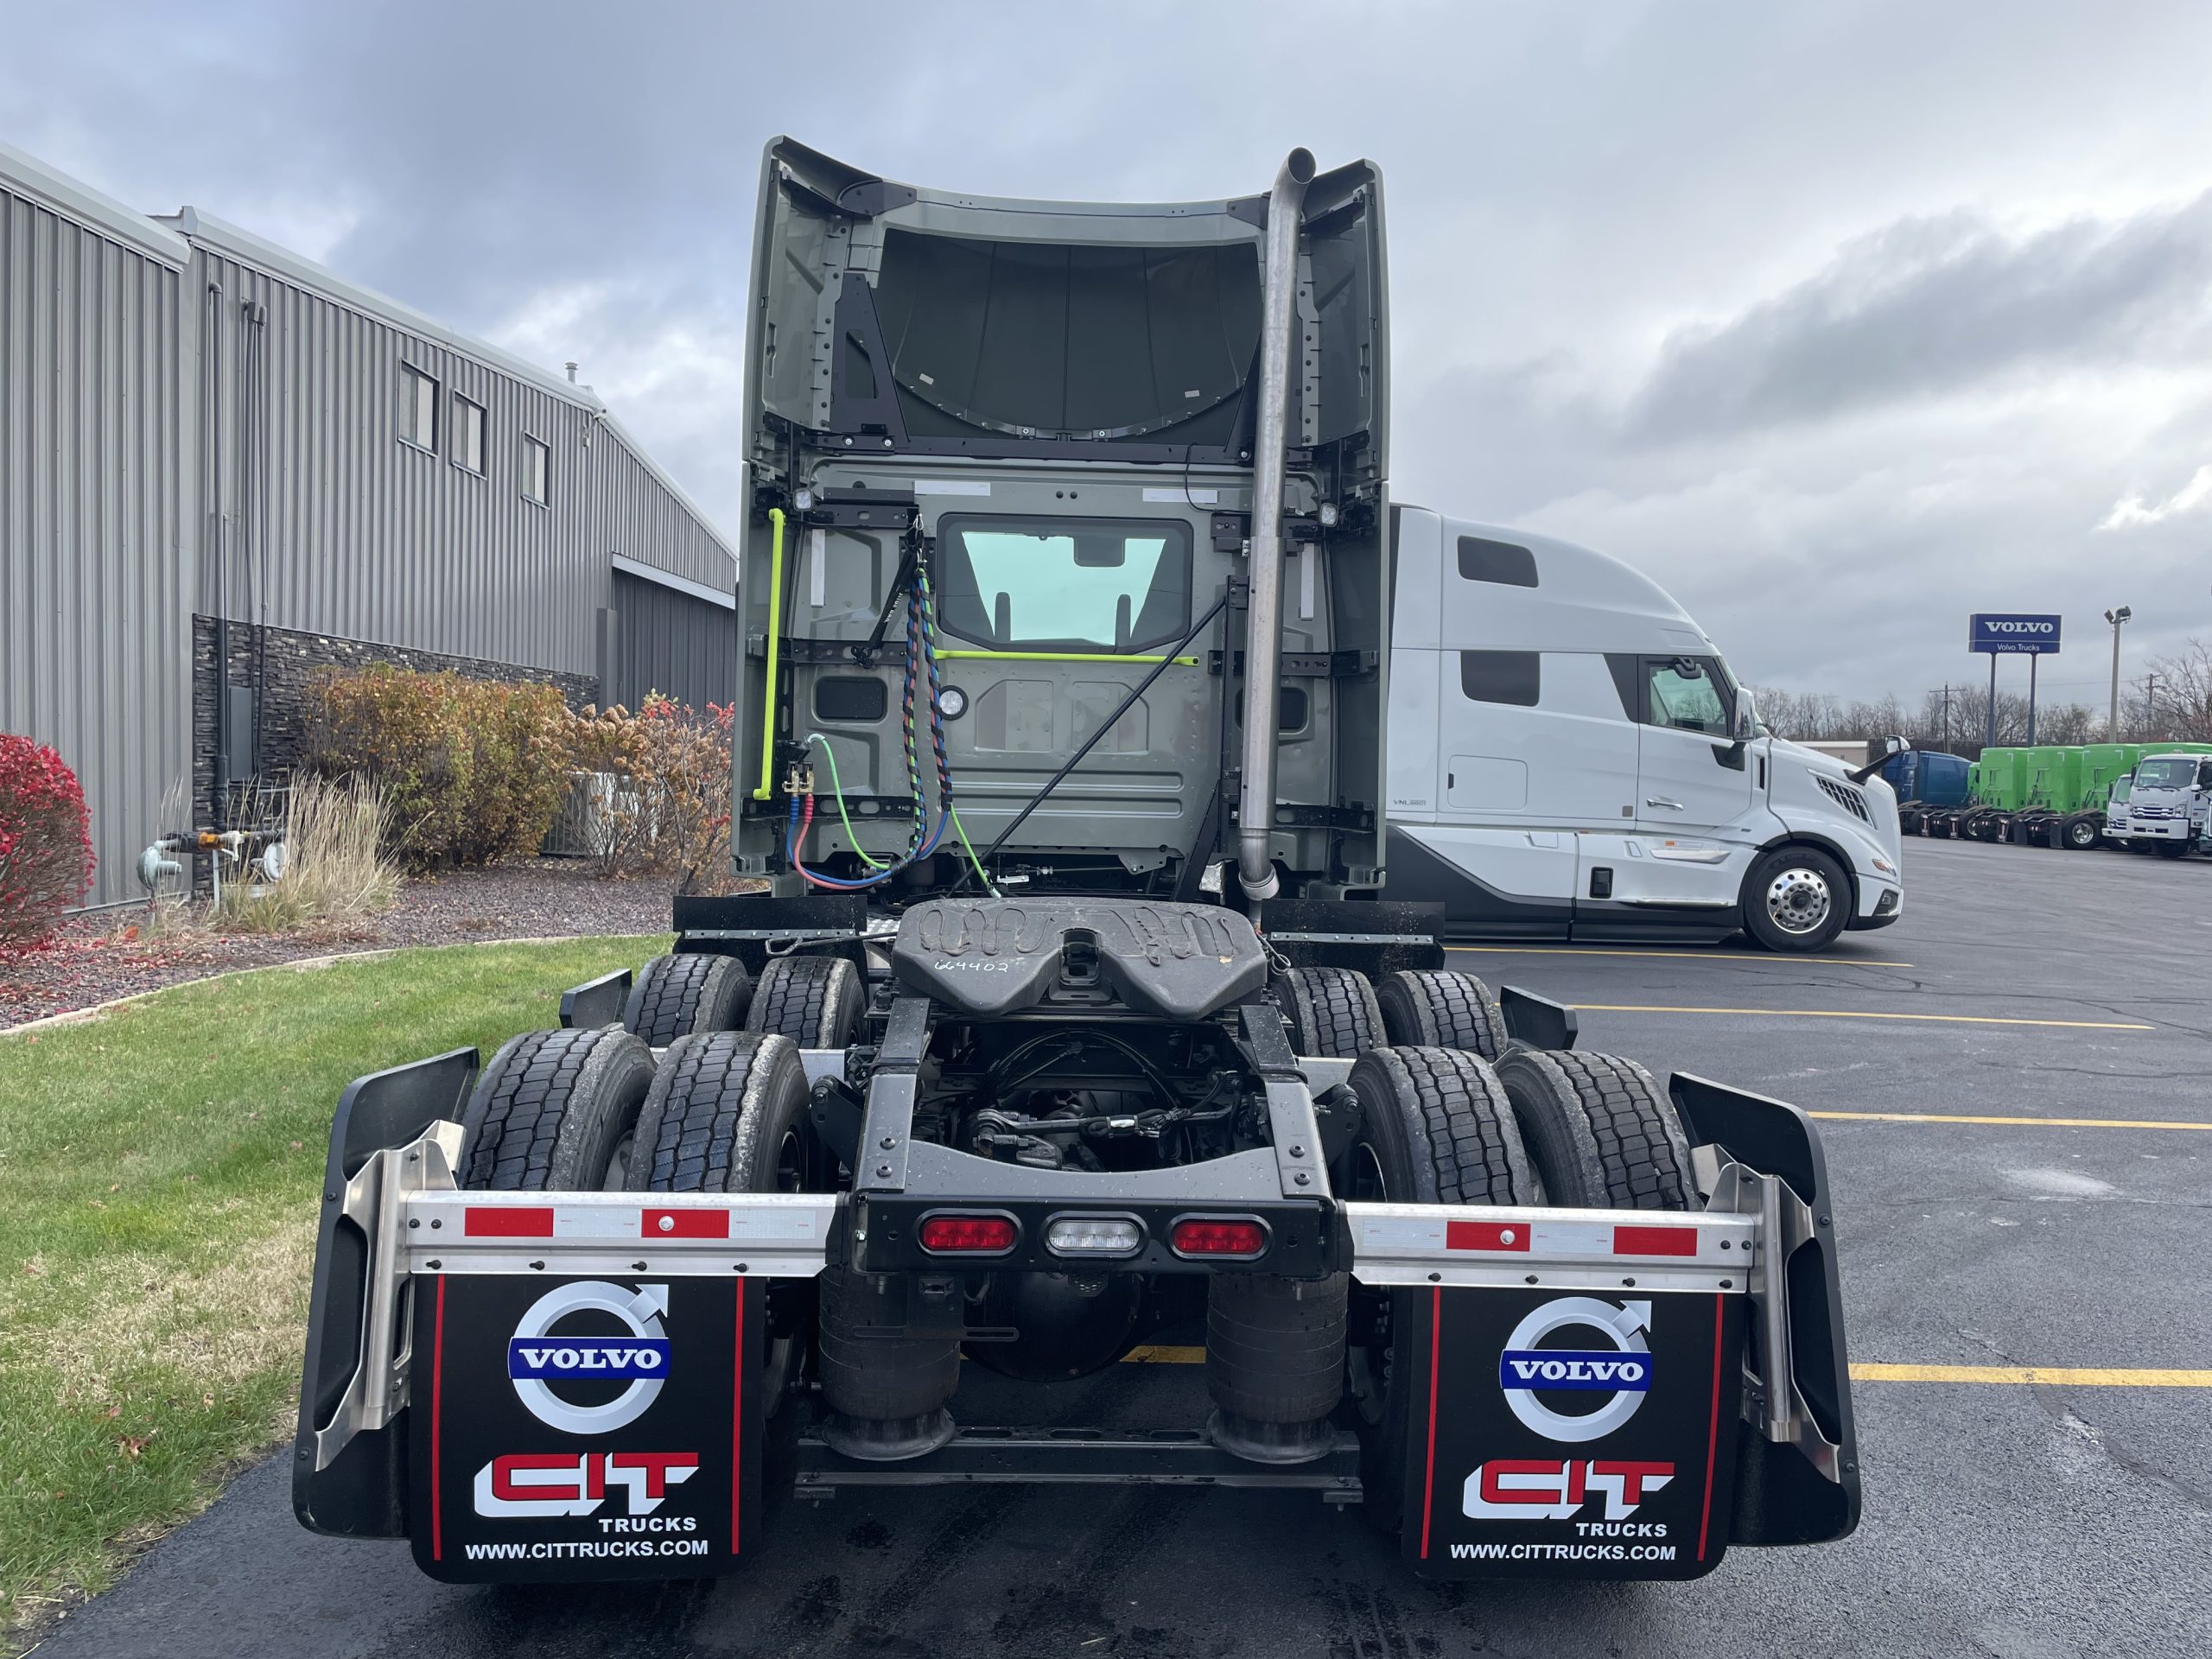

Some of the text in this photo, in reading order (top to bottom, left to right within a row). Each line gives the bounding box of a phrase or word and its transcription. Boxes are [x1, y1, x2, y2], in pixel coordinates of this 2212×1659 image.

[1985, 621, 2054, 633] VOLVO
[1997, 643, 2040, 652] Volvo Trucks
[934, 960, 1008, 973] 664402
[518, 1348, 662, 1370] VOLVO
[1510, 1360, 1644, 1382] VOLVO
[474, 1452, 700, 1518] CIT
[1462, 1459, 1675, 1521] CIT
[599, 1516, 697, 1534] TRUCKS
[1576, 1522, 1668, 1538] TRUCKS
[465, 1539, 709, 1560] WWW.CITTRUCKS.COM
[1450, 1543, 1676, 1561] WWW.CITTRUCKS.COM
